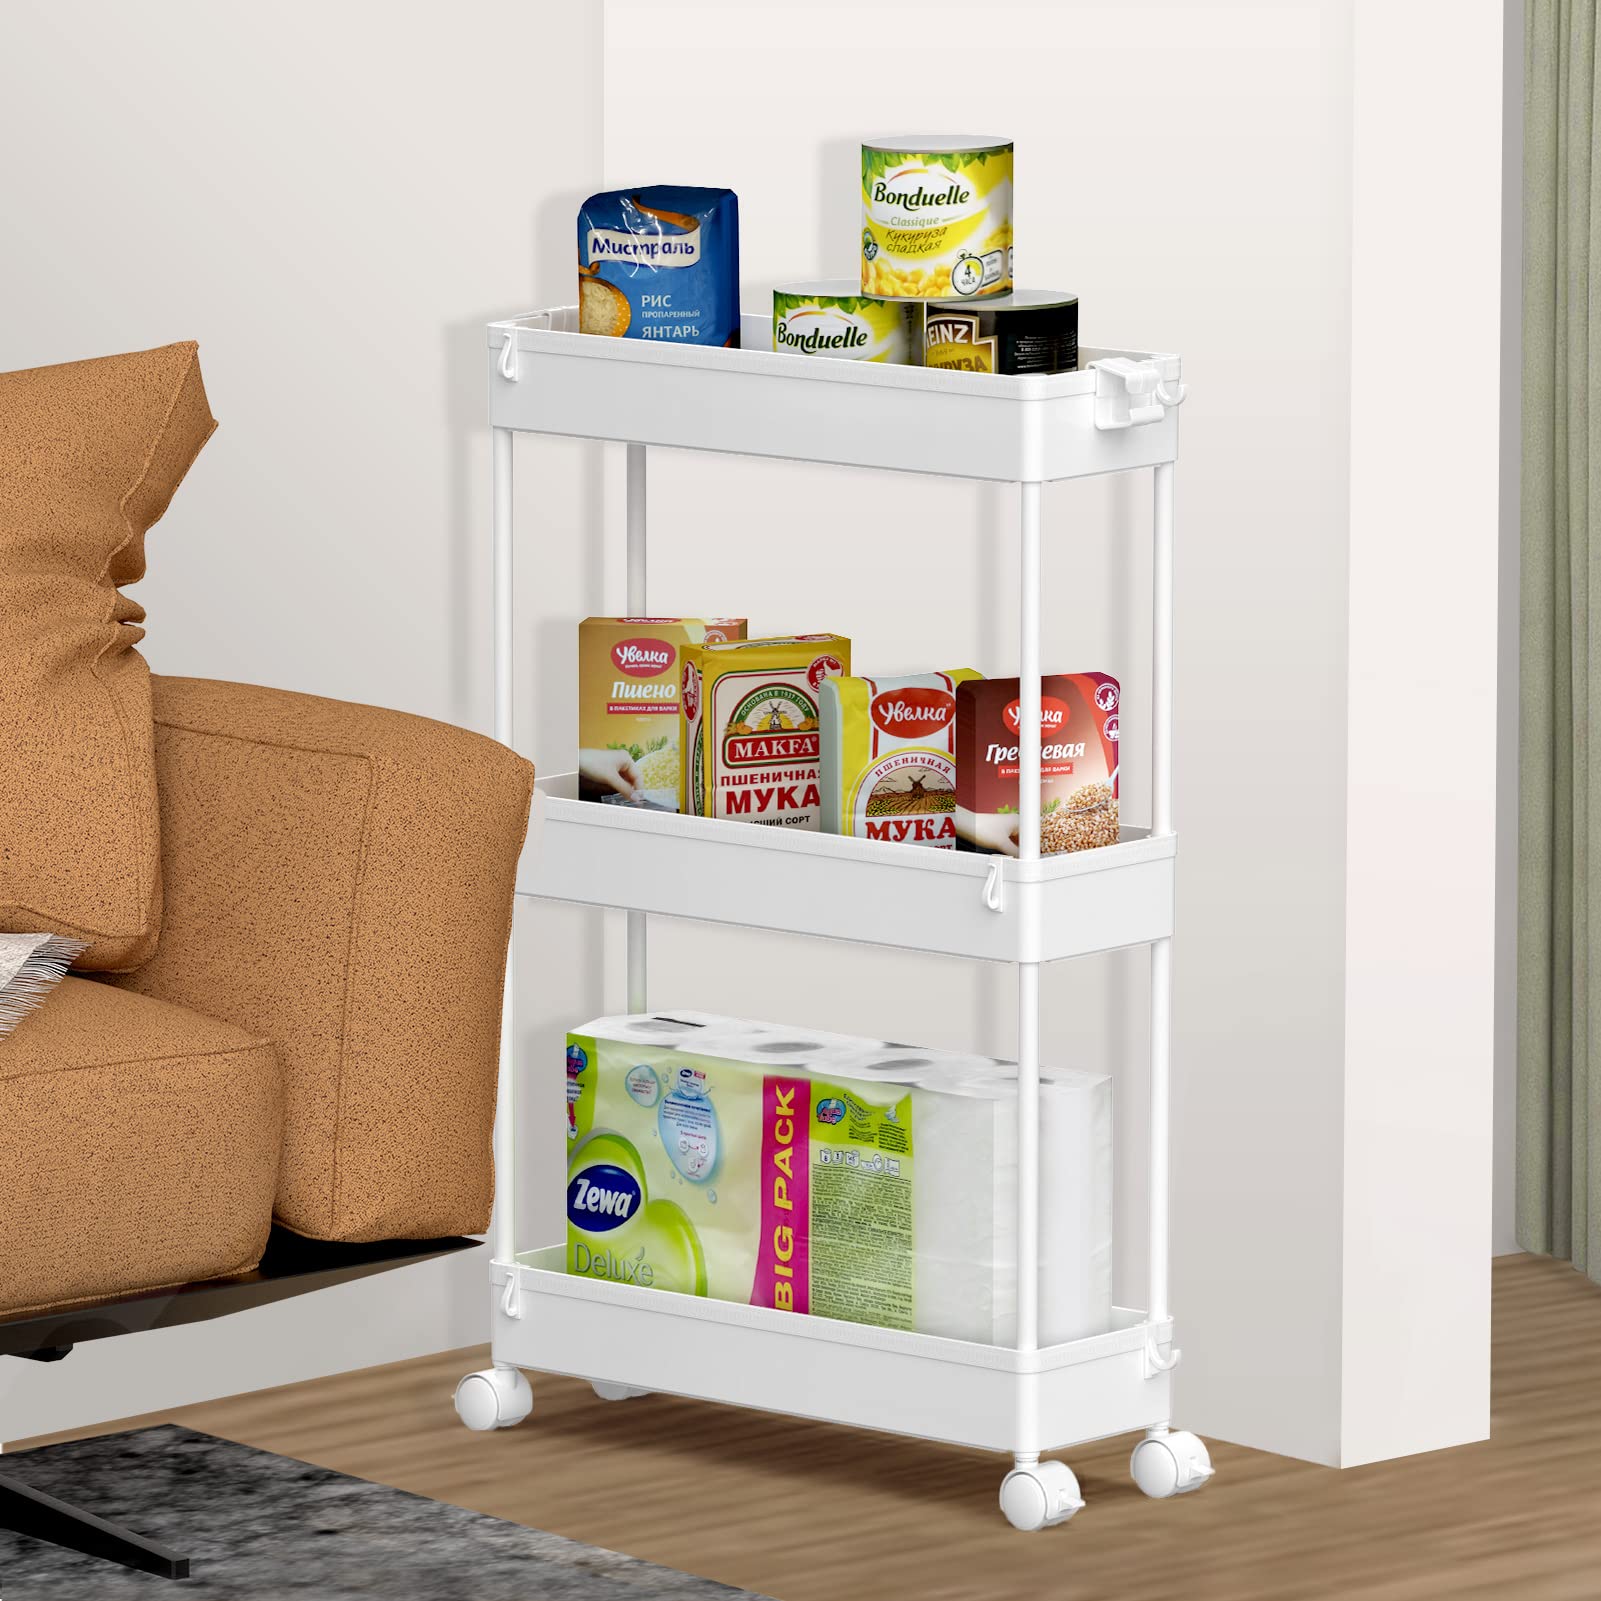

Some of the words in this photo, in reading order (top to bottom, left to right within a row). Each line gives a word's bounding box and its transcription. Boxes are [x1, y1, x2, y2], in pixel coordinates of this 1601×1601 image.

[874, 181, 970, 211] Bonduelle
[890, 215, 940, 228] Classique
[886, 226, 948, 244] Кукуруза
[592, 237, 695, 259] Мистраль
[965, 264, 971, 277] 4
[641, 295, 672, 308] РИС
[641, 309, 700, 319] ПРОПАРЕННЫЙ
[642, 325, 700, 339] ЯНТАРЬ
[777, 321, 868, 354] Bonduelle
[926, 323, 969, 349] EINZ
[616, 645, 669, 664] Увелка
[611, 681, 677, 699] Пшено
[741, 690, 773, 716] ОСНОВАНА
[878, 701, 946, 725] Увелка
[734, 738, 816, 759] MAKFA
[720, 769, 821, 787] ПШЕНИЧНА
[874, 756, 951, 778] ПШЕНИЧНАЯ
[725, 784, 821, 815] МУКА
[785, 815, 811, 825] СОРТ
[865, 816, 956, 843] МУКА
[774, 1084, 796, 1211] PACK
[573, 1178, 633, 1218] Zewa
[573, 1241, 655, 1287] Deluxe
[774, 1225, 794, 1312] BIG
